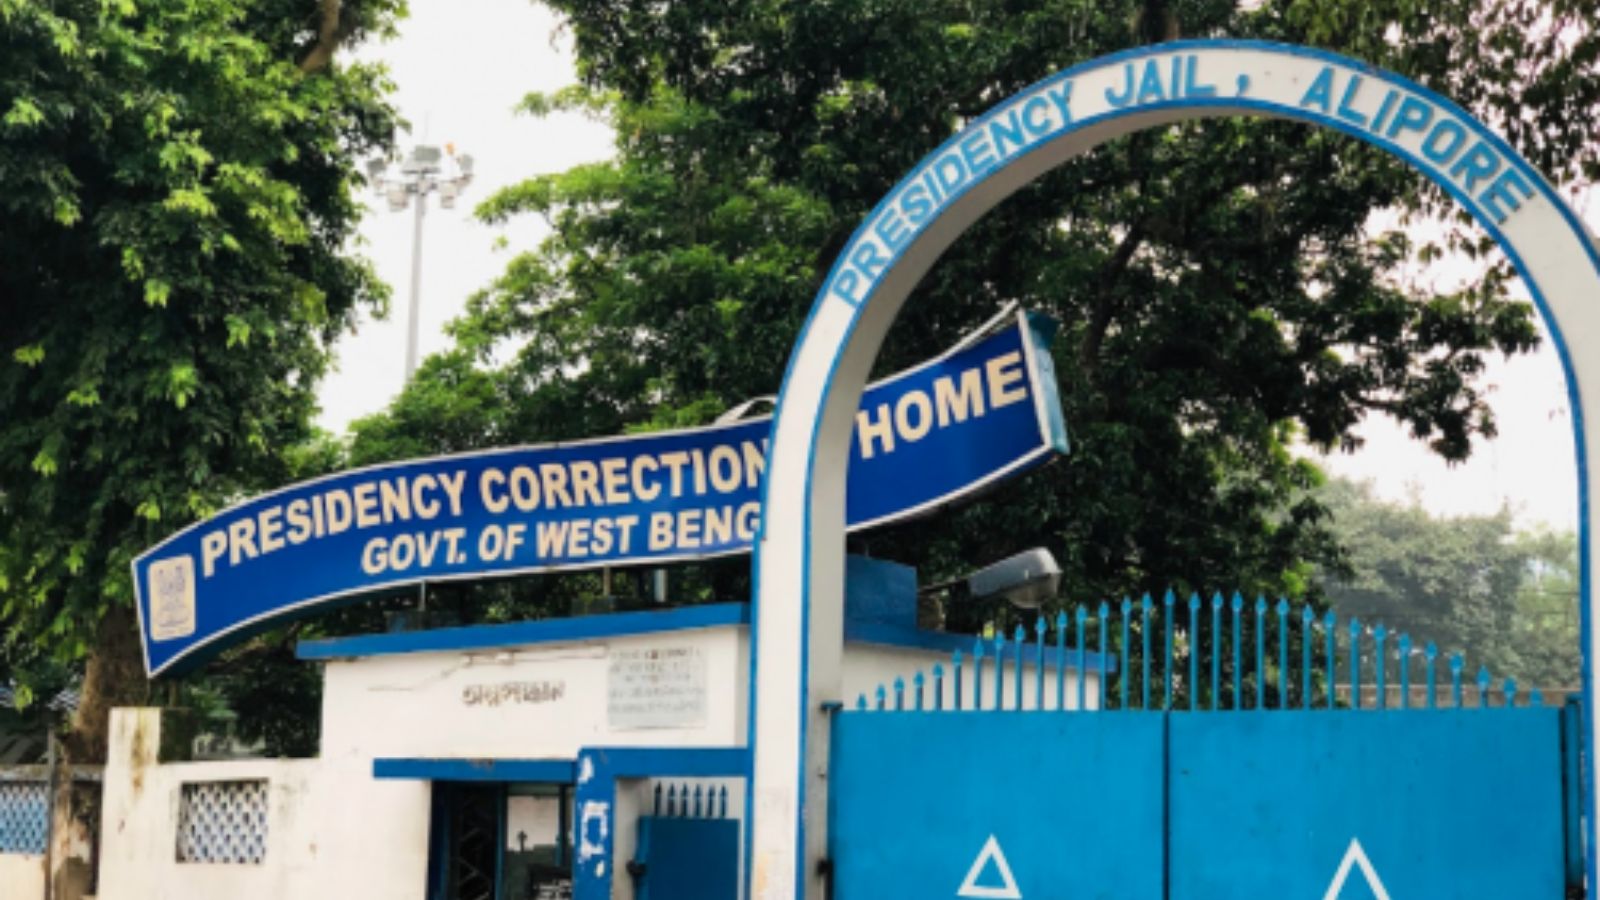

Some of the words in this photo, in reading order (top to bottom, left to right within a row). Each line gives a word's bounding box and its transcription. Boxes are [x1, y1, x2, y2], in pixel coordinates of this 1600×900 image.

[834, 81, 1074, 306] PRESIDENCY
[1300, 66, 1536, 223] ALIPORE
[201, 471, 467, 578] PRESIDENCY
[855, 351, 1028, 460] HOME
[362, 527, 468, 575] GOVT.
[478, 524, 525, 562] OF
[534, 517, 639, 557] WEST
